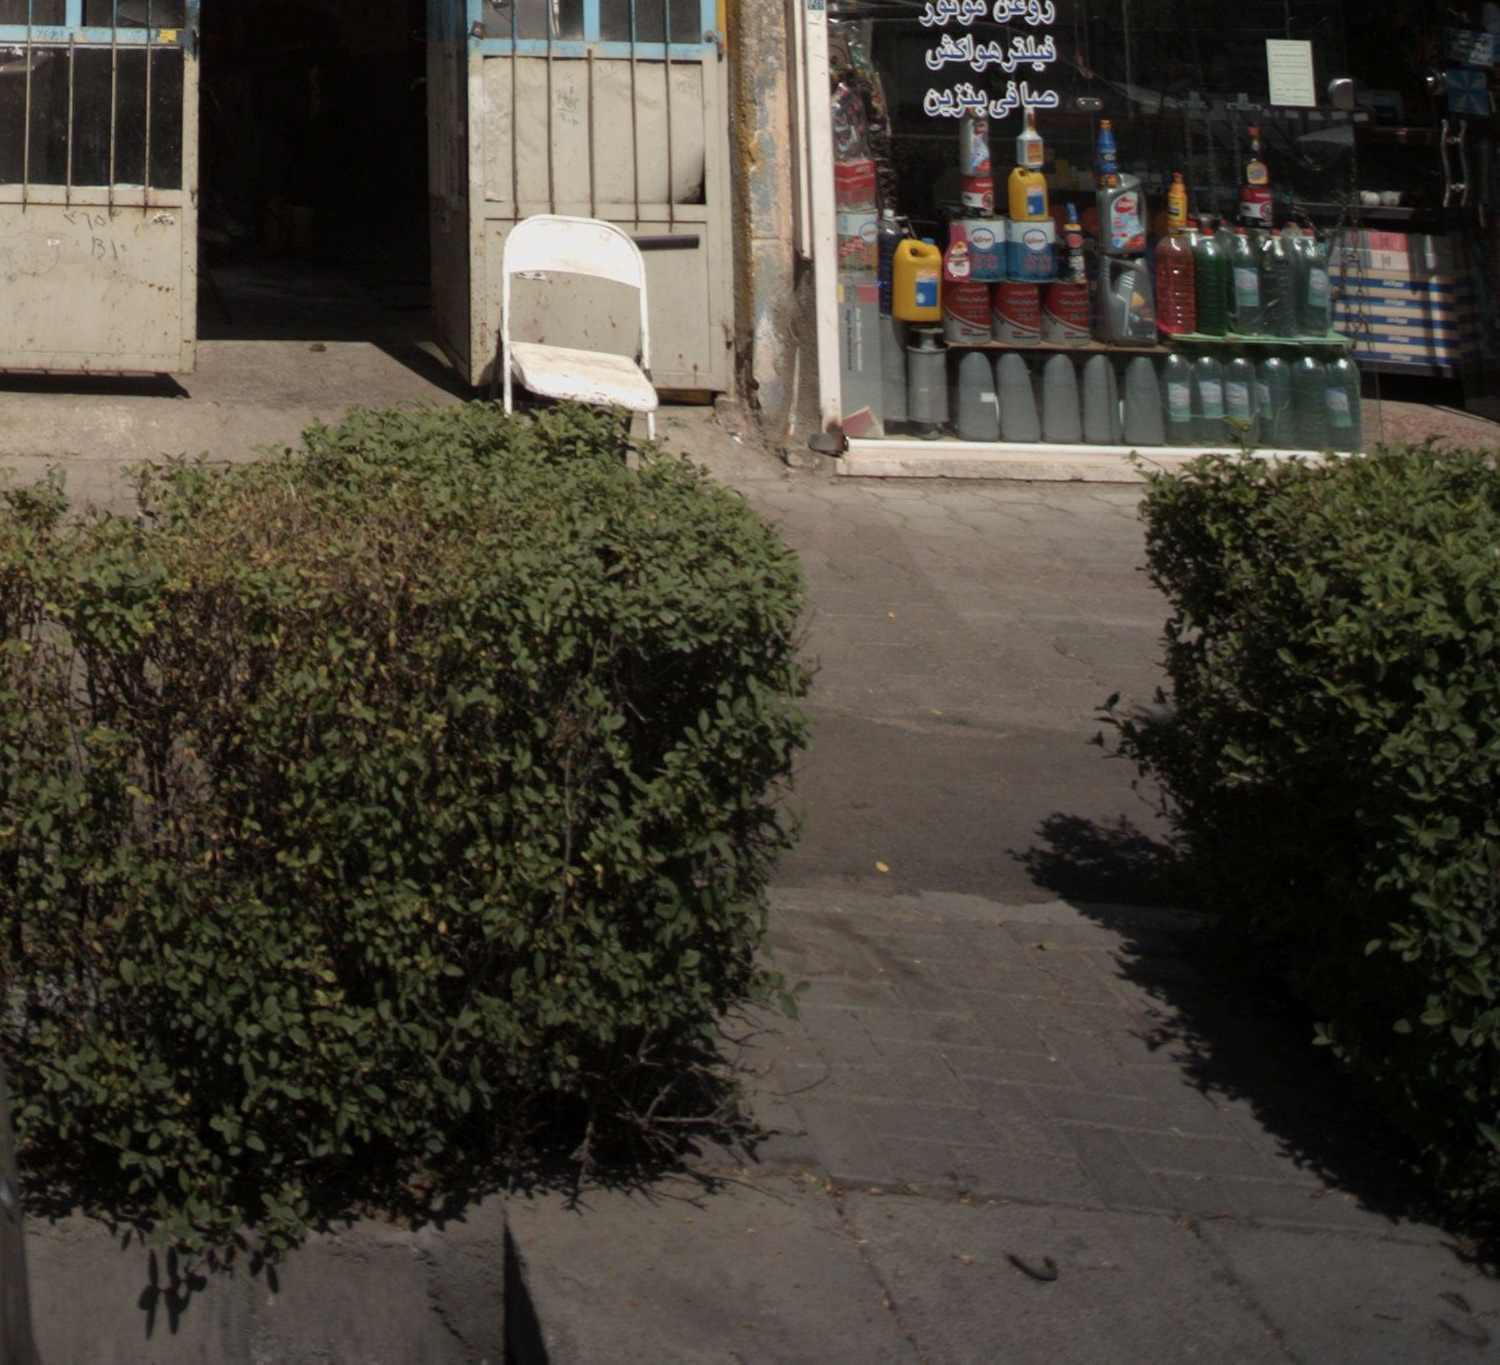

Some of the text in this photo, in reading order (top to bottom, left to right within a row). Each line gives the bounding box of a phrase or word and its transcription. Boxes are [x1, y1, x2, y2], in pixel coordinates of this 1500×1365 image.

[926, 33, 1057, 72] فیلتر هواکش
[923, 80, 1059, 118] صافی بنزین
